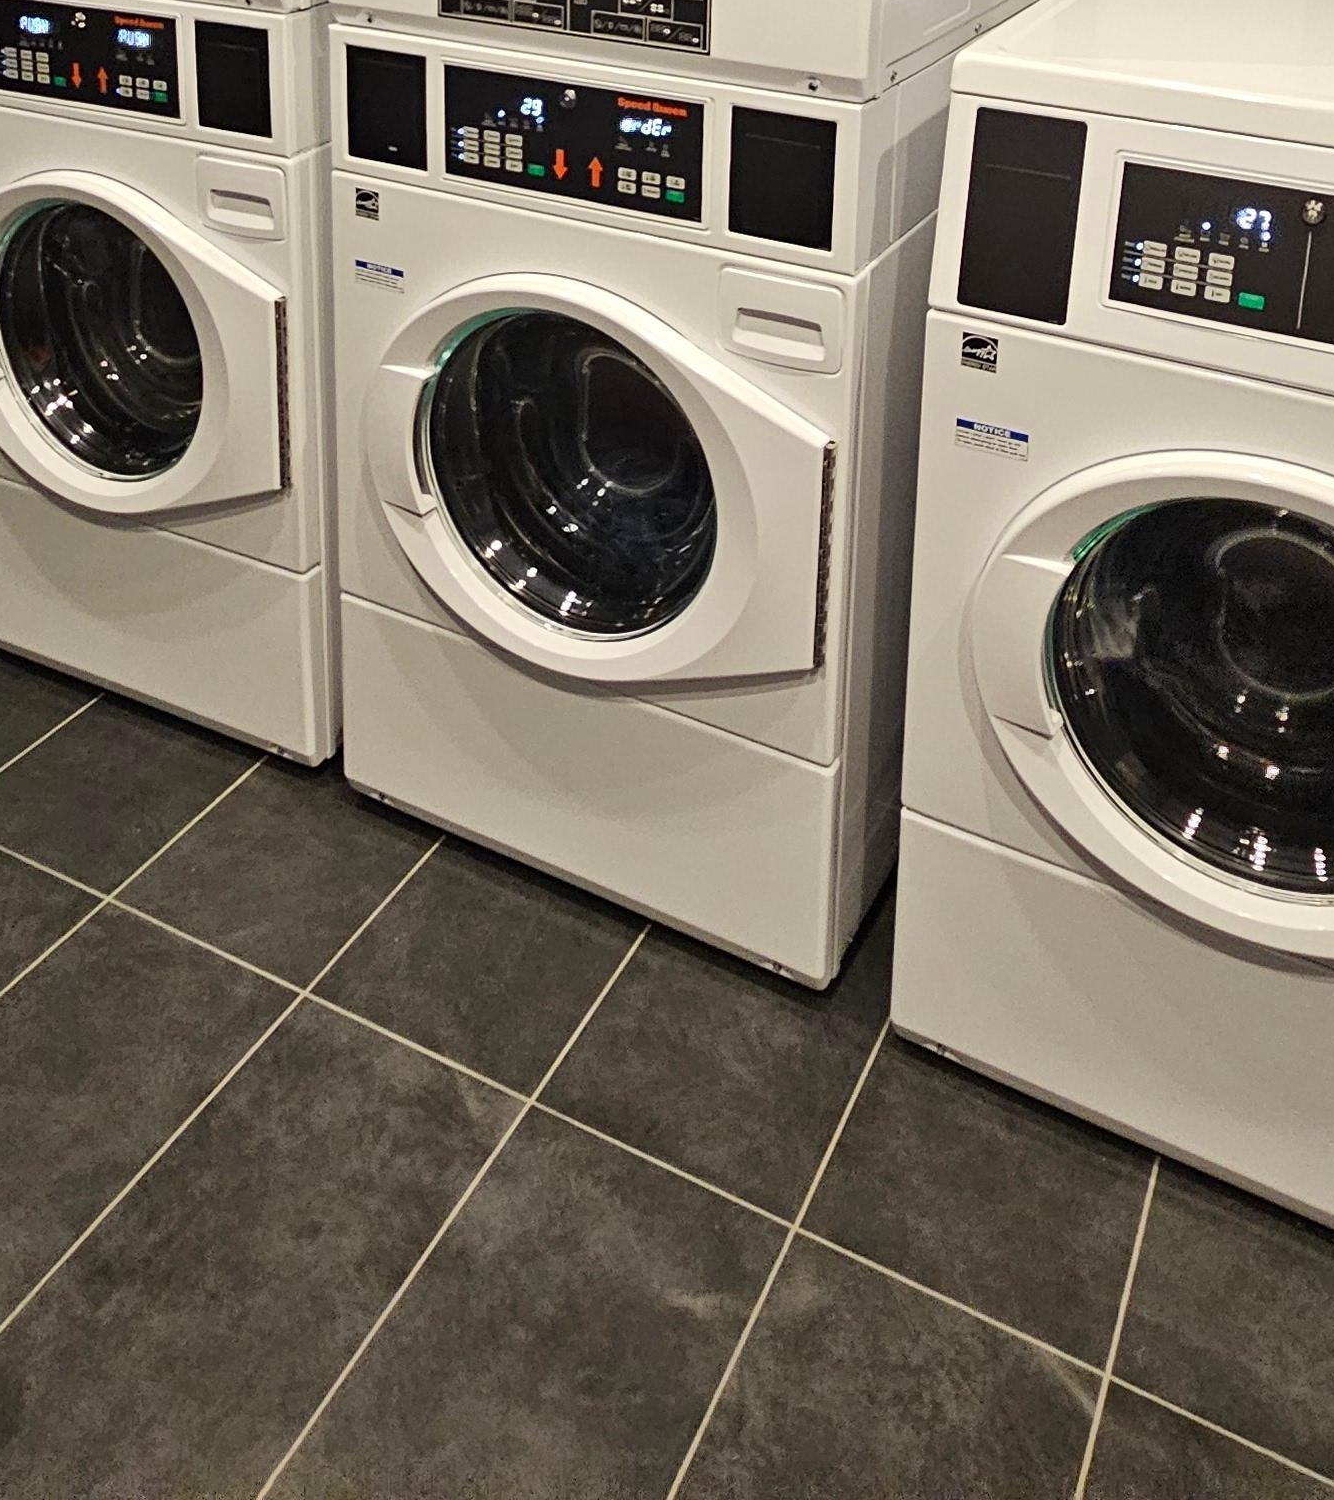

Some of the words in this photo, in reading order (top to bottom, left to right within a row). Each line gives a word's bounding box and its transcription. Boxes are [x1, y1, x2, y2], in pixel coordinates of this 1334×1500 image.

[520, 97, 543, 117] 29
[1236, 208, 1272, 230] 27
[973, 423, 1012, 439] NOTICE
